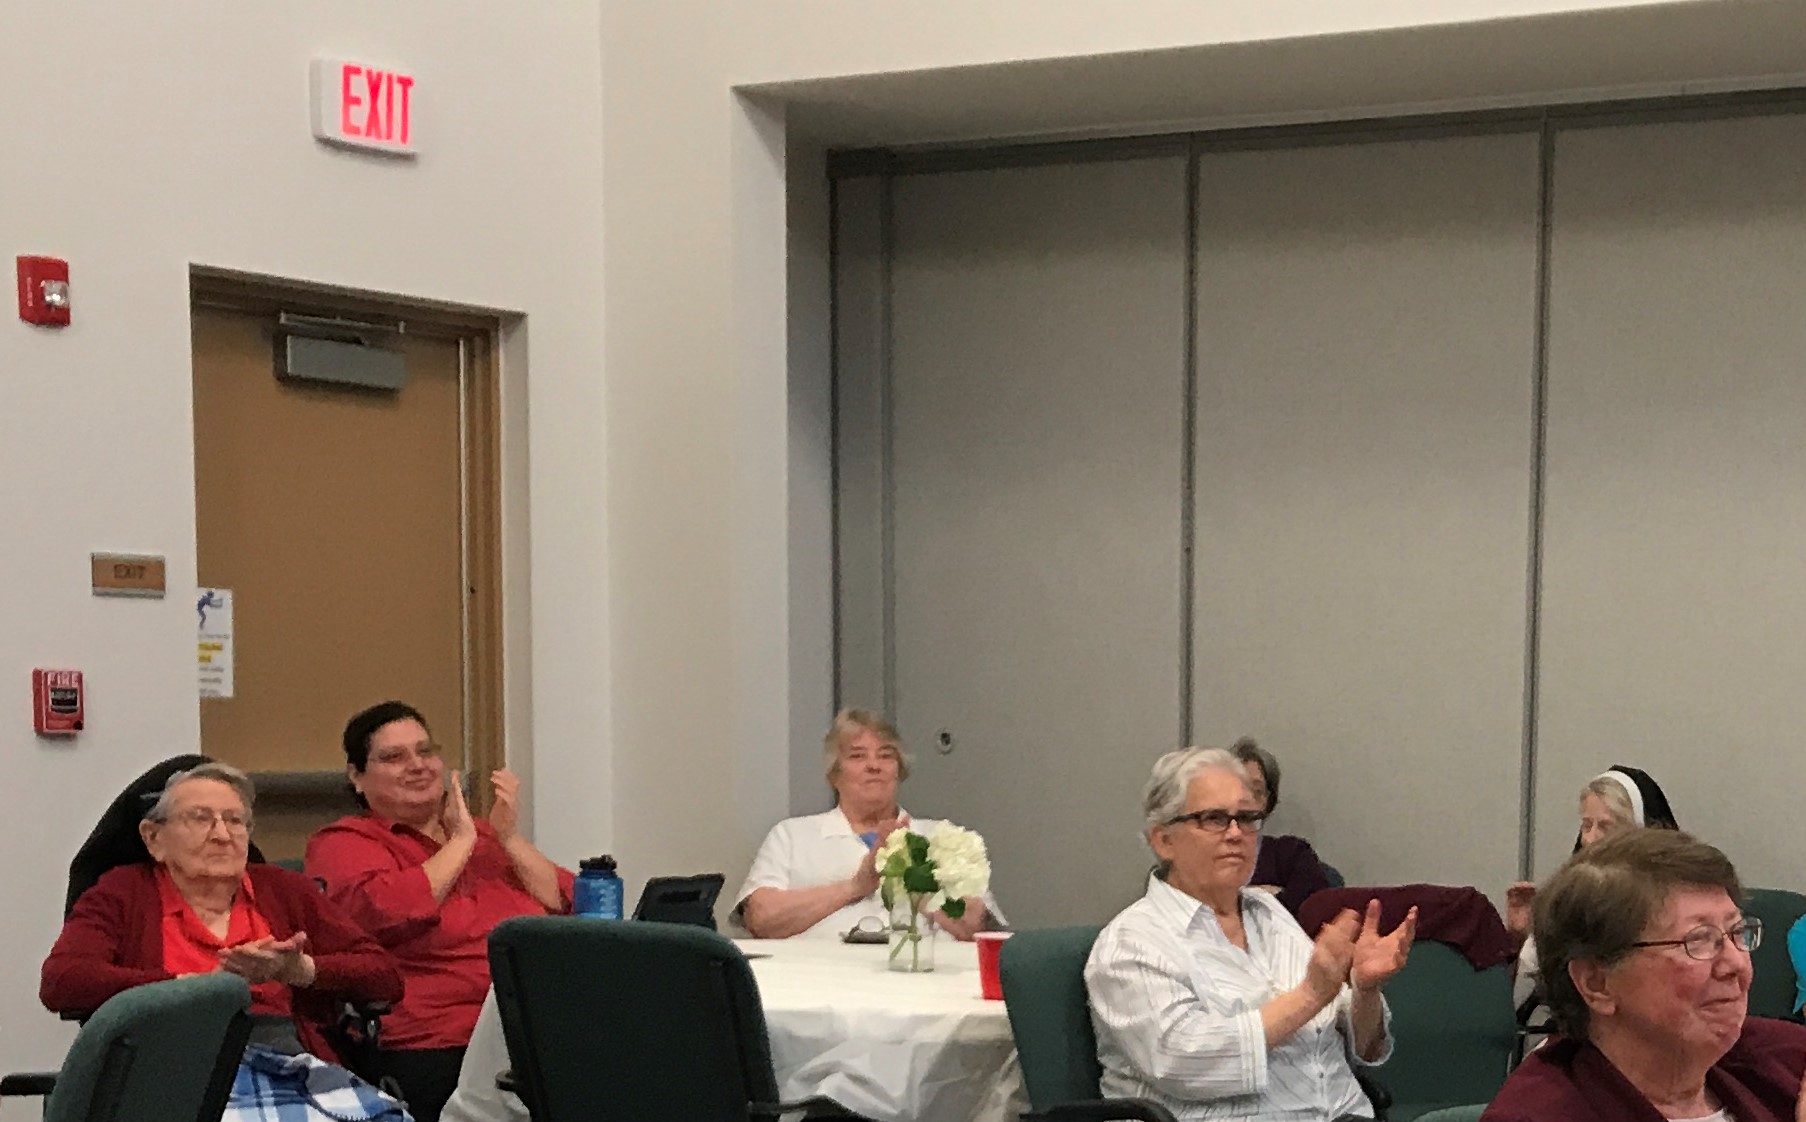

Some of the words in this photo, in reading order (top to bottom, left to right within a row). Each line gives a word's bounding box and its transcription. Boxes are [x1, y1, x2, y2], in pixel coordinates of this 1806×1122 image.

[341, 64, 414, 145] EXIT
[114, 564, 146, 579] EXIT
[47, 671, 79, 687] FIRE
